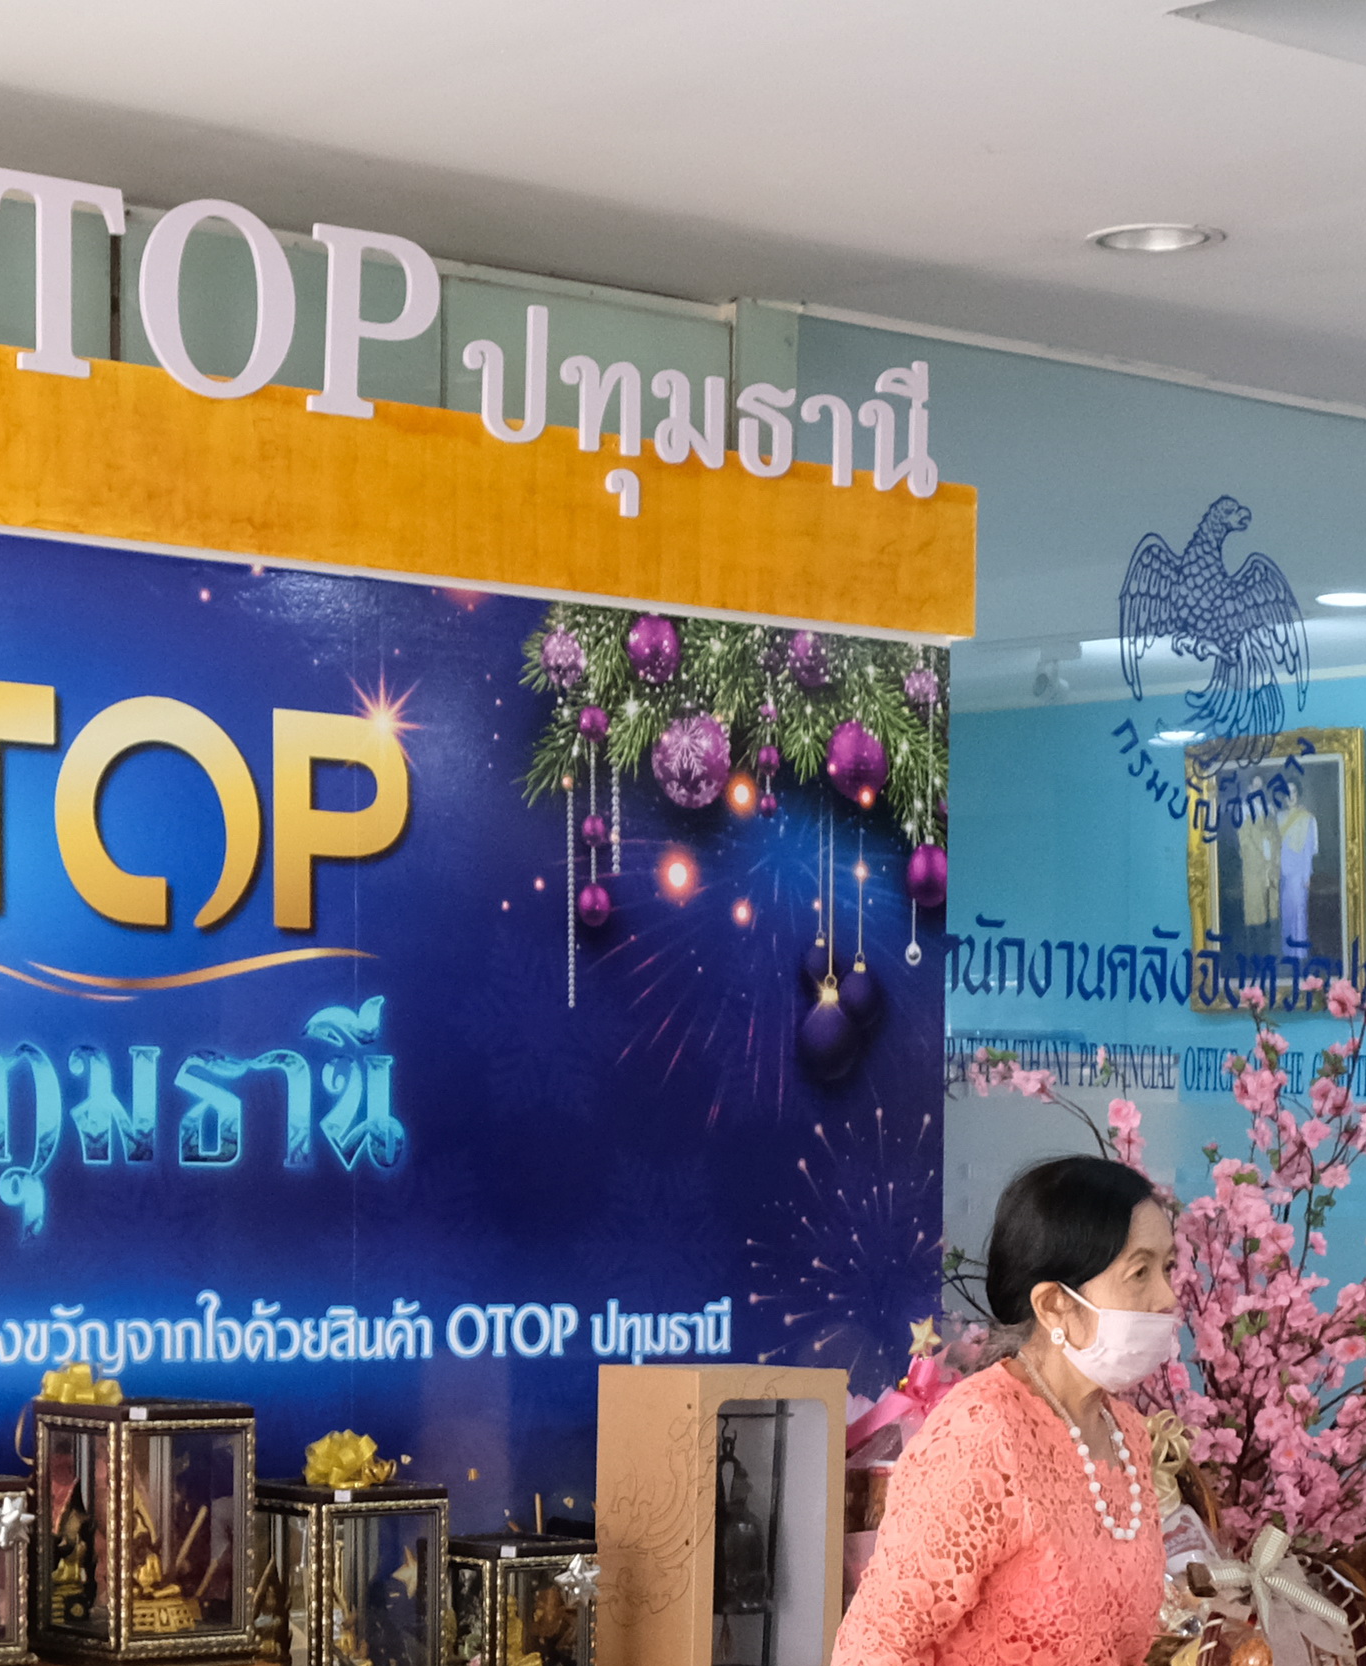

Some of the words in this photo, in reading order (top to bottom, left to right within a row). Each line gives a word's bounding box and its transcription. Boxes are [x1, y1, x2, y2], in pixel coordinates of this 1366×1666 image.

[462, 305, 940, 518] ปทุมธานี
[445, 1303, 579, 1358] OTOP
[591, 1296, 732, 1366] ปทุมธานี
